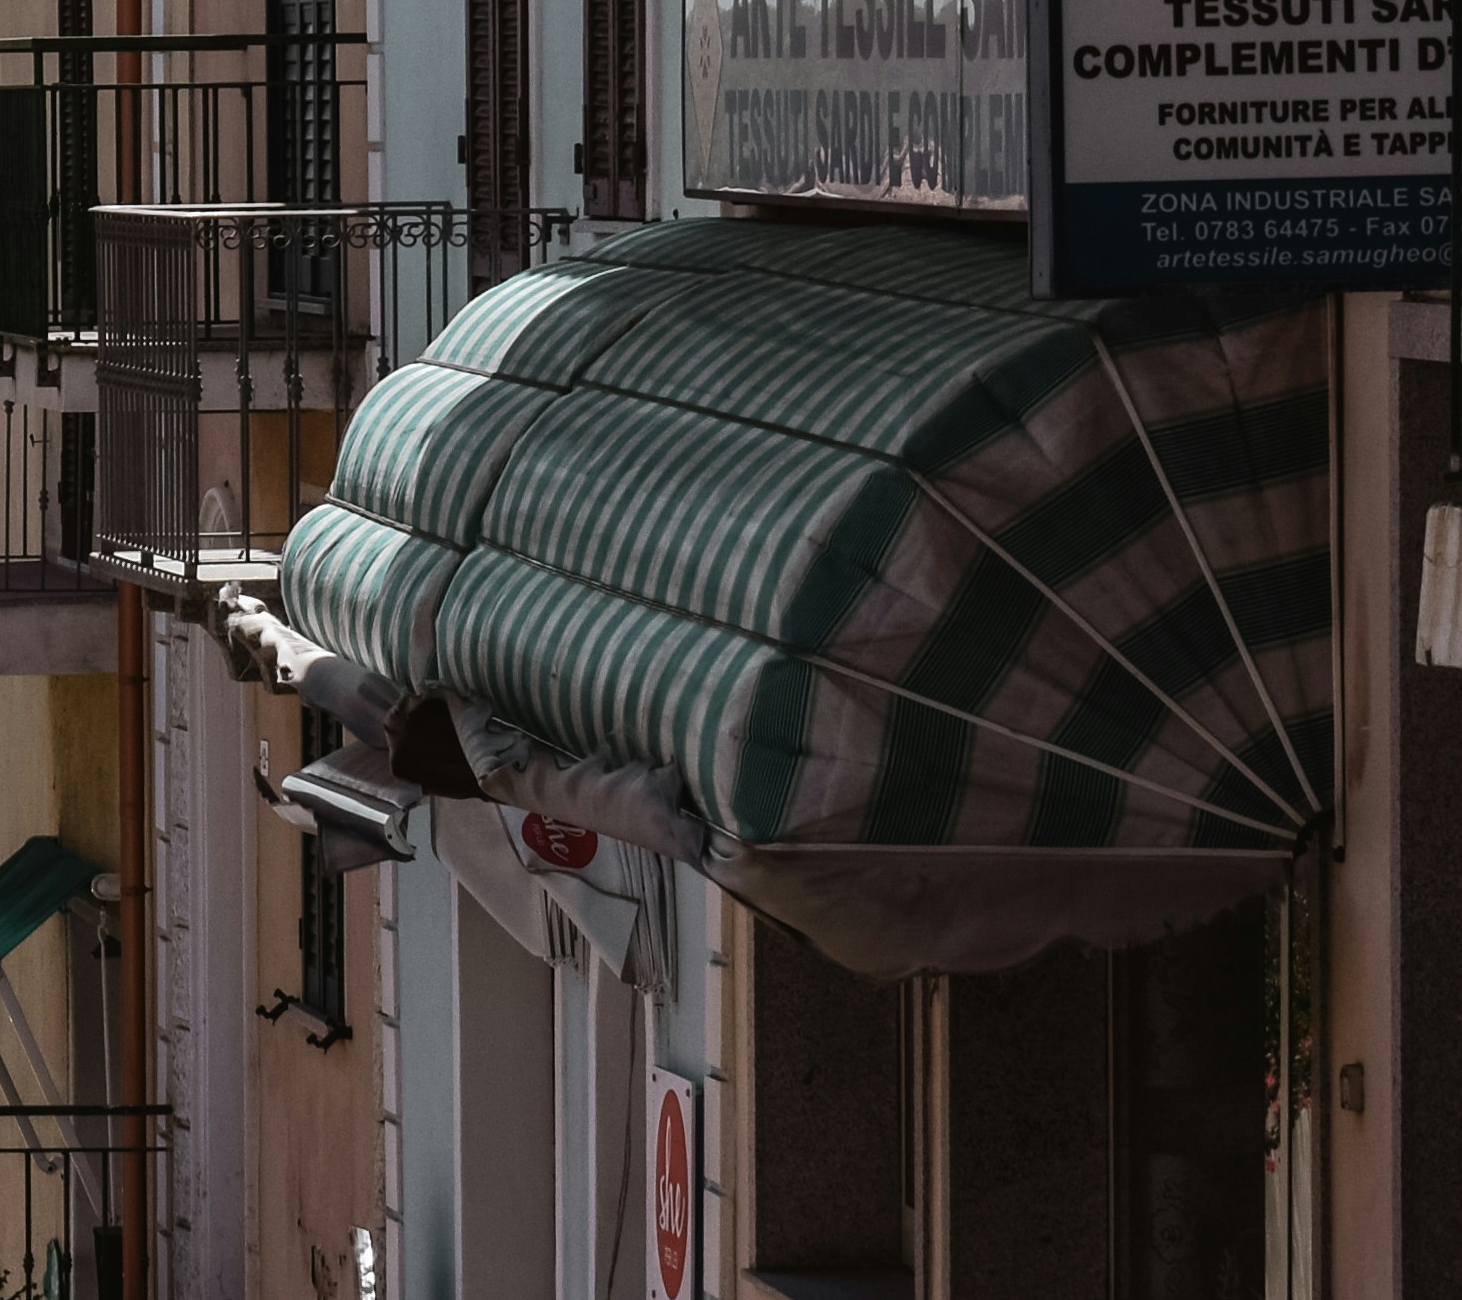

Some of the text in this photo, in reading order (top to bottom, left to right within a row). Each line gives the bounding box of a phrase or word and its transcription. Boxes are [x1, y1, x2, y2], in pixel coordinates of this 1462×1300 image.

[1073, 38, 1400, 80] COMPLEMENTI
[1158, 99, 1330, 126] FORNITURE
[1340, 97, 1397, 121] PER
[724, 89, 809, 182] TESSUTI
[816, 89, 881, 186] SARDI
[888, 91, 901, 188] E
[1173, 129, 1453, 161] COMUNITÀ E TAPP
[1141, 192, 1218, 213] ZONA
[1227, 187, 1409, 212] INDUSTRIALE
[1141, 221, 1185, 242] Tel.
[1195, 220, 1255, 240] 0783
[1264, 217, 1340, 239] 64475
[1366, 216, 1411, 237] Fax
[1420, 215, 1449, 235] 07
[1156, 242, 1453, 270] artetessile.samugheo@
[659, 1115, 686, 1239] she
